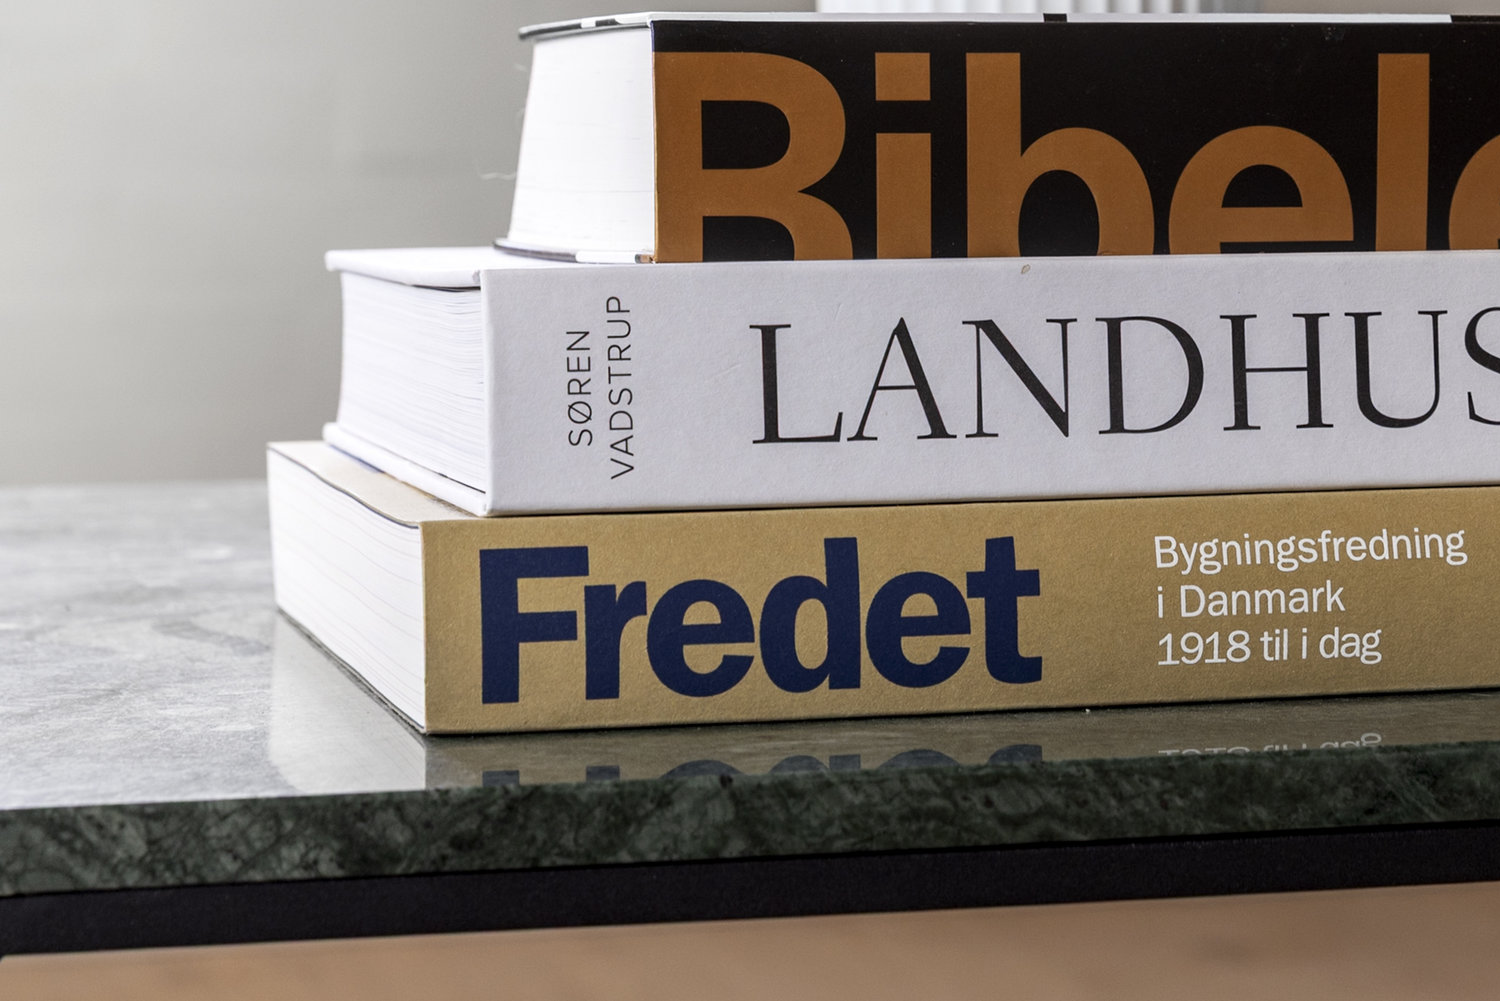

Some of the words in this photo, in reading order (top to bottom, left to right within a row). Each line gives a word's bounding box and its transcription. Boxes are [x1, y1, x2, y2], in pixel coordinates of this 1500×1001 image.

[566, 330, 593, 446] SØREN
[606, 296, 635, 480] VADSTRUP
[1154, 527, 1469, 575] Bygningsfredning
[479, 536, 1043, 705] Fredet
[1157, 586, 1164, 618] i
[1180, 579, 1346, 618] Danmark
[1158, 630, 1251, 666] 1918
[1260, 628, 1289, 661] til
[1301, 628, 1308, 659] i
[1319, 627, 1383, 665] dag
